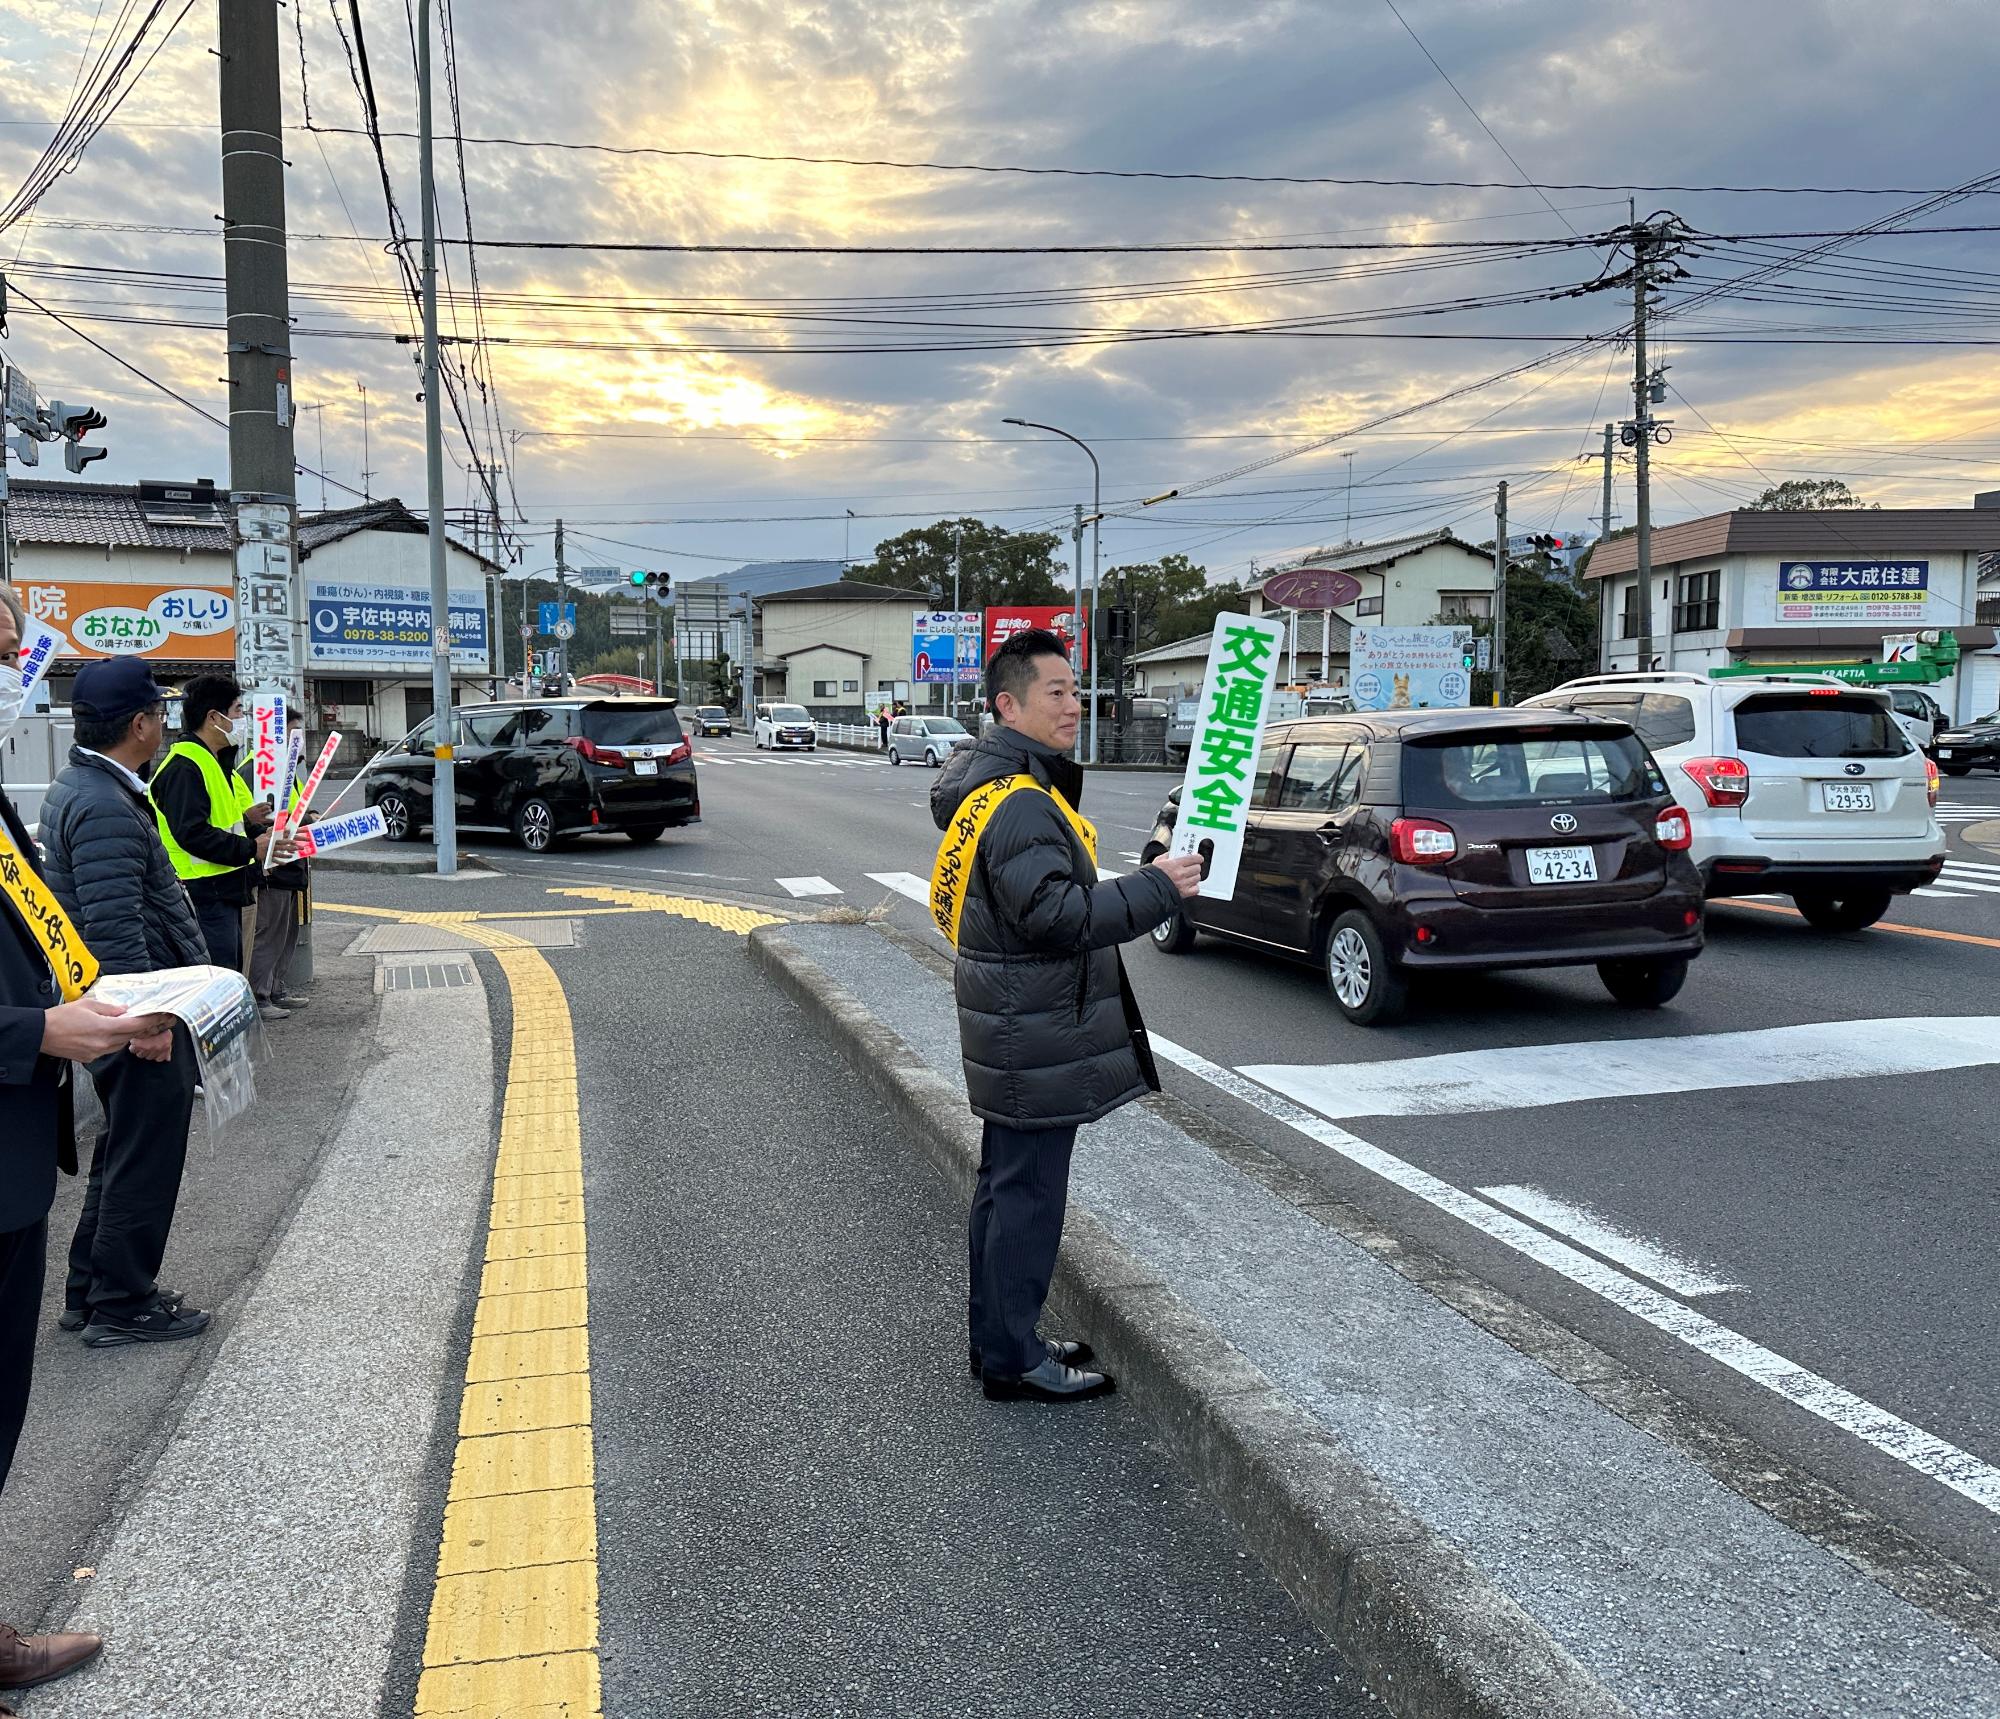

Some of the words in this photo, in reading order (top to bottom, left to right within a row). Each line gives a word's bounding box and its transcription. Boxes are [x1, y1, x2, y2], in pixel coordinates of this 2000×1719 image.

[1820, 567, 1839, 577] 有限
[1820, 577, 1839, 586] 会社
[1840, 567, 1921, 586] 大成住建
[12, 585, 67, 621] 院
[316, 585, 477, 605] 腫瘍(がん)・内視鏡・糖尿ご相談
[1871, 592, 1922, 600] 0120-5788-38
[162, 597, 228, 619] おしり
[84, 615, 161, 637] おなか
[182, 620, 212, 629] が痛い
[342, 607, 481, 630] 宇佐中央内病院
[994, 618, 1032, 628] 車検の
[94, 639, 153, 648] の調子が悪い
[344, 629, 429, 642] 0978-38-5200
[326, 647, 364, 656] 北へ車で5分
[21, 635, 52, 697] 後部座席
[274, 697, 284, 744] 後部座席も
[1187, 625, 1275, 832] 交通安全
[256, 707, 275, 790] シートベルト
[1836, 795, 1871, 808] 29-53
[312, 812, 381, 848] 交通安全運動
[934, 776, 1016, 946] 命を守る交通
[1533, 867, 1542, 875] の
[1545, 861, 1593, 880] 42-34
[0, 852, 92, 990] 命を守る
